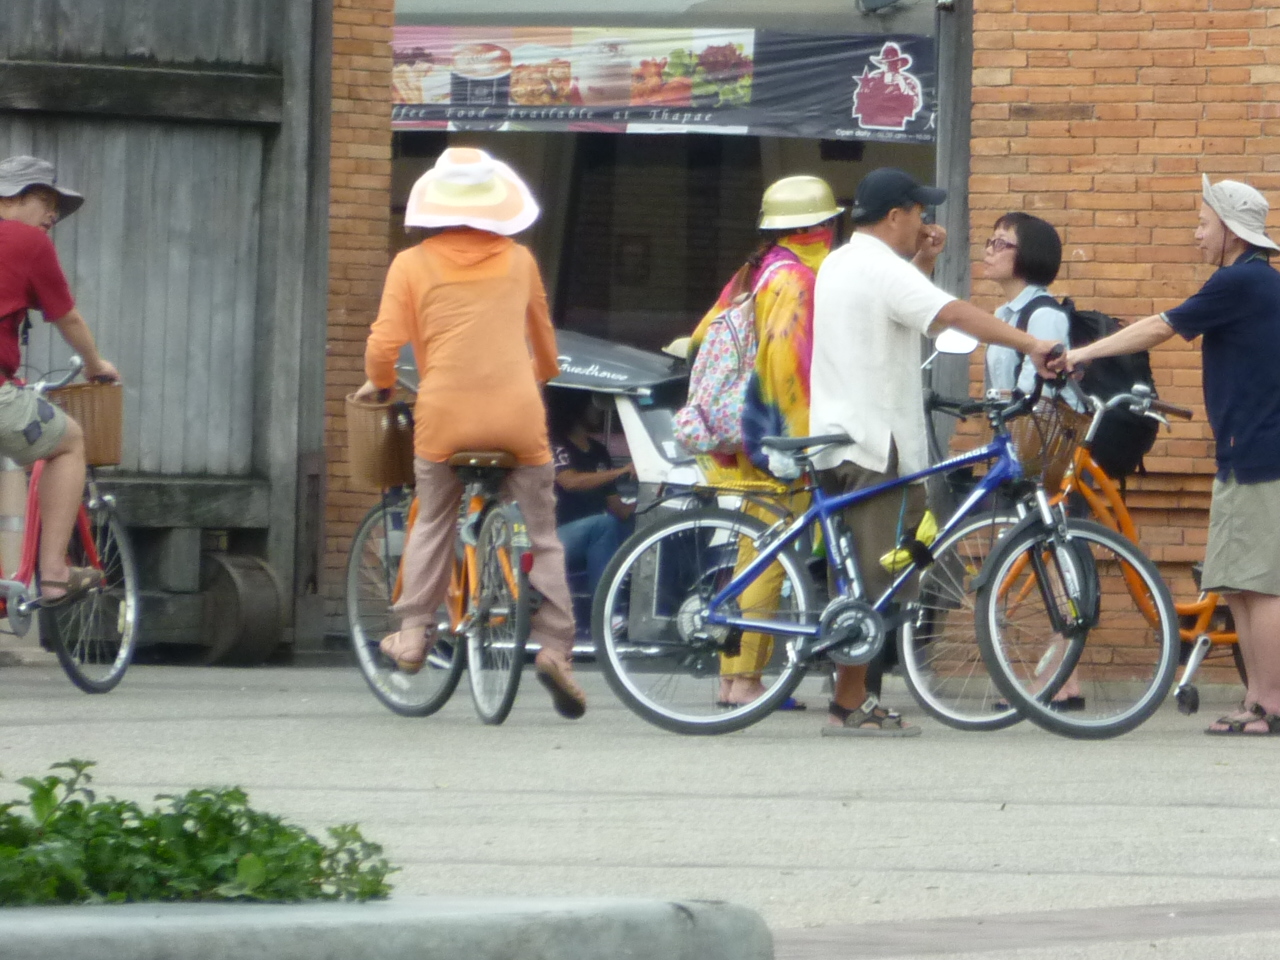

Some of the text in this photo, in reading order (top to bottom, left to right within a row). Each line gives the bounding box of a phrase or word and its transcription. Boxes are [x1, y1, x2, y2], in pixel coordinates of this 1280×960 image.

[445, 106, 489, 118] Food
[504, 107, 593, 119] Available
[612, 110, 629, 120] at
[650, 109, 713, 123] Thapae
